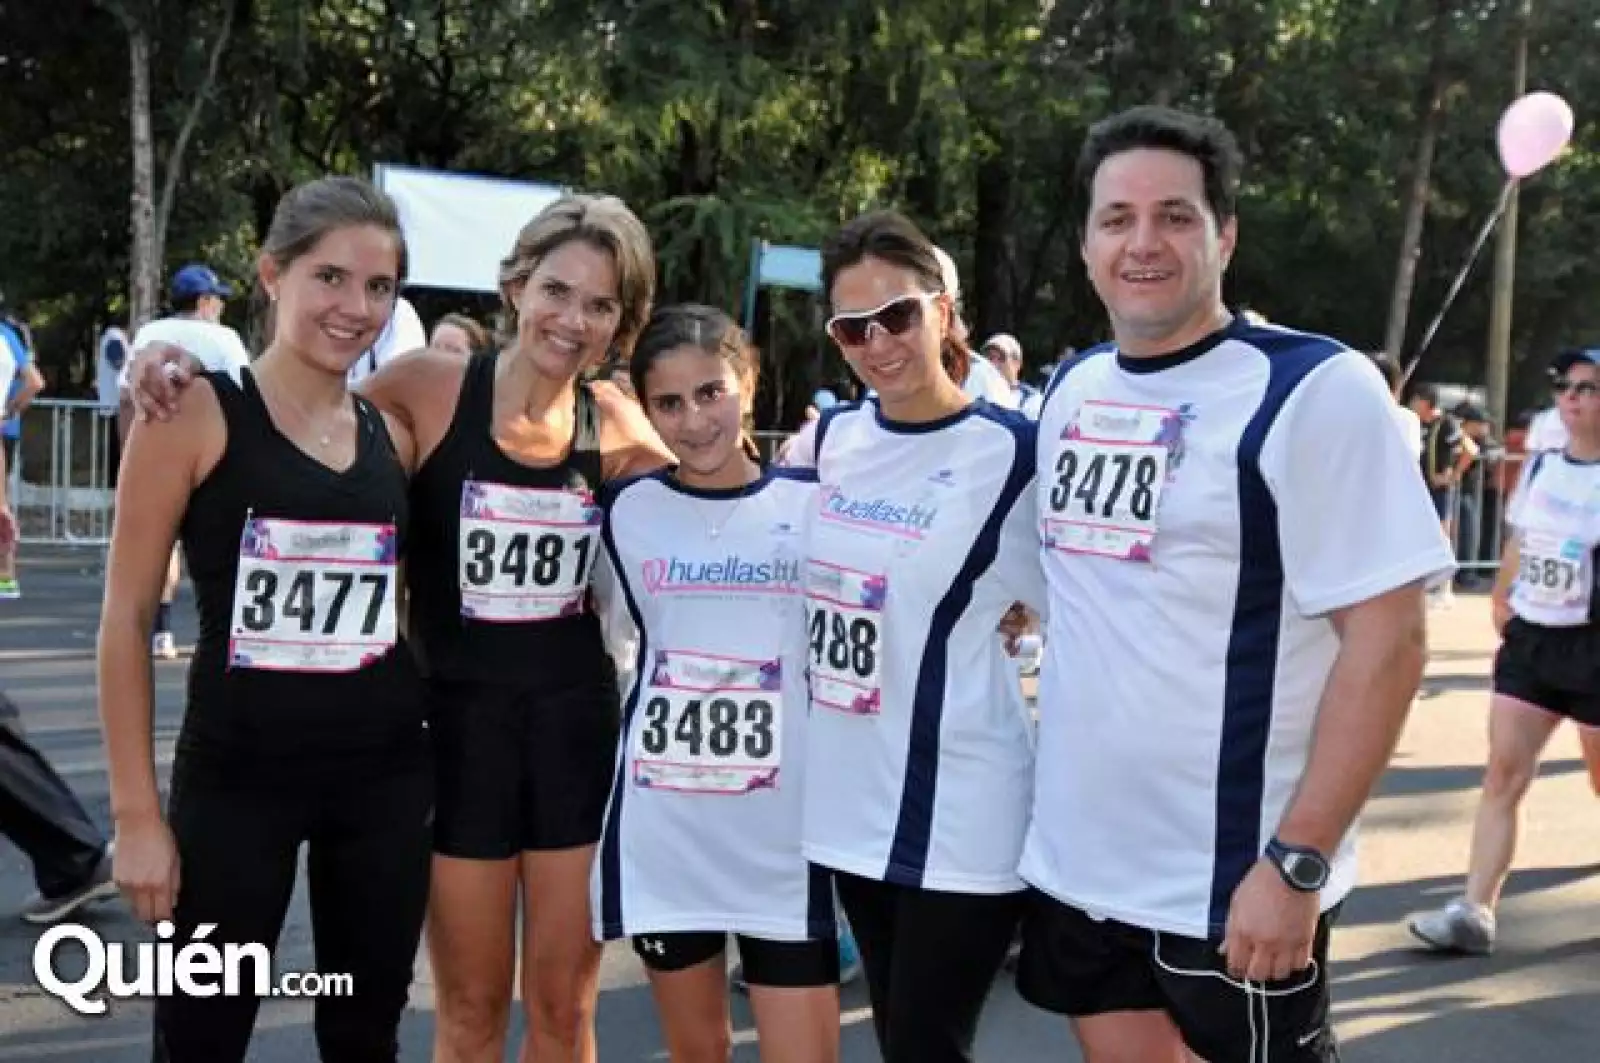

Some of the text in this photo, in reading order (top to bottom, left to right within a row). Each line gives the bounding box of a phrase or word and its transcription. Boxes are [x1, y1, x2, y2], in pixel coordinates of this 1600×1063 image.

[1051, 449, 1157, 521] 3478
[466, 528, 591, 586] 3481
[242, 569, 389, 636] 3477
[641, 696, 774, 759] 3483
